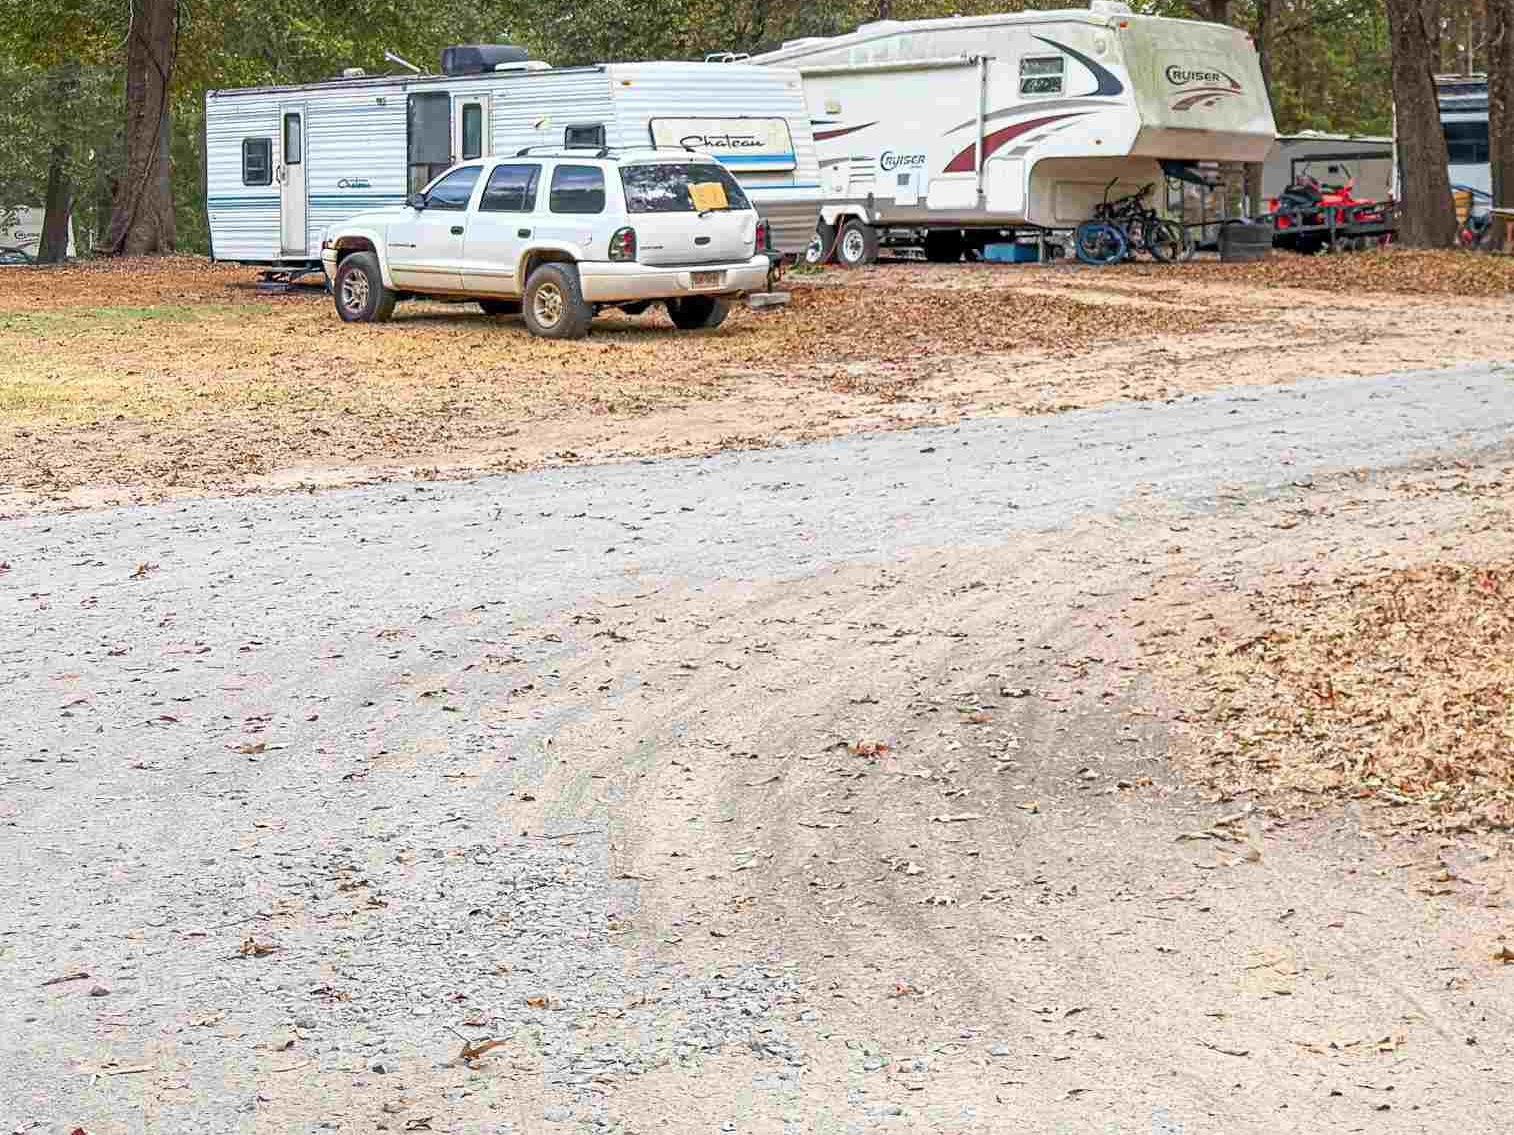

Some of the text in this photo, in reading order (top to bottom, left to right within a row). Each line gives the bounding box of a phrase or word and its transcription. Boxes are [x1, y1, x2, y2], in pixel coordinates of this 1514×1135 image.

[1166, 65, 1220, 85] CRUISER
[680, 133, 765, 152] Chateau
[880, 150, 926, 171] CRUISER
